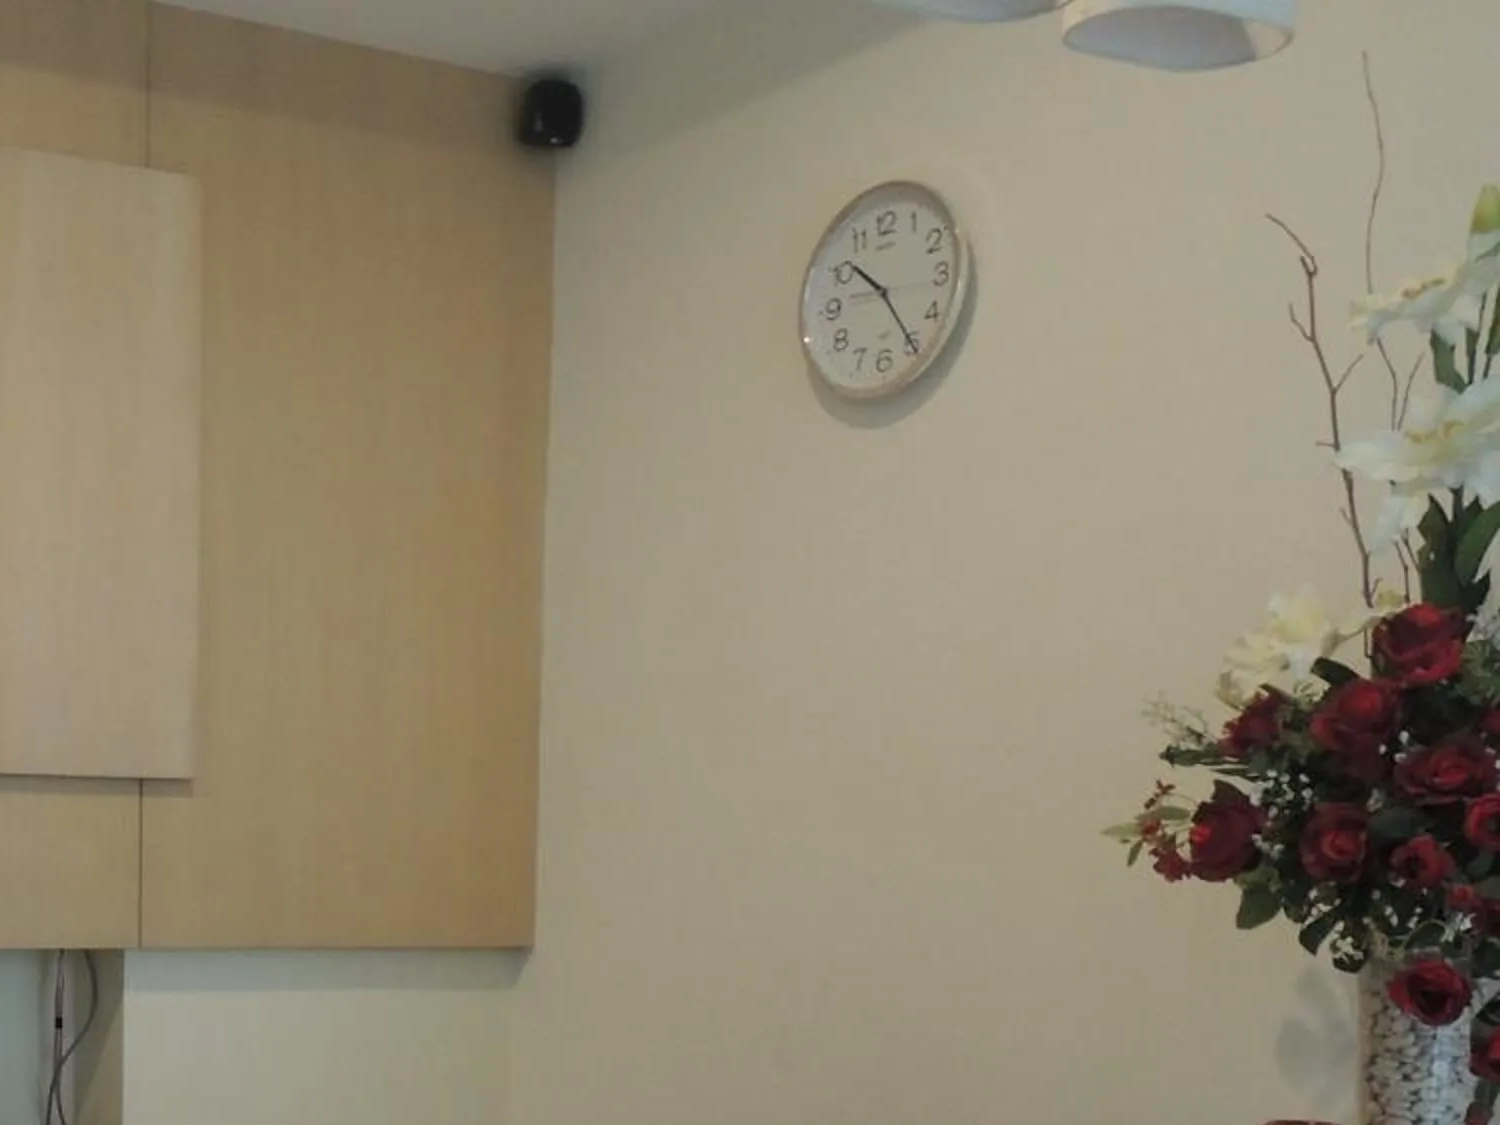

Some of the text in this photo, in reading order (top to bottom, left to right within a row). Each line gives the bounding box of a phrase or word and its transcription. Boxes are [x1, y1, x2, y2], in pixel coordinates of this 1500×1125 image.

[875, 210, 898, 238] 12
[910, 211, 917, 233] 1
[853, 226, 867, 253] 11
[925, 227, 943, 254] 2
[932, 260, 949, 288] 3
[825, 297, 842, 321] 9
[923, 300, 940, 323] 4
[832, 327, 849, 352] 8
[853, 347, 868, 371] 7
[875, 348, 894, 374] 6
